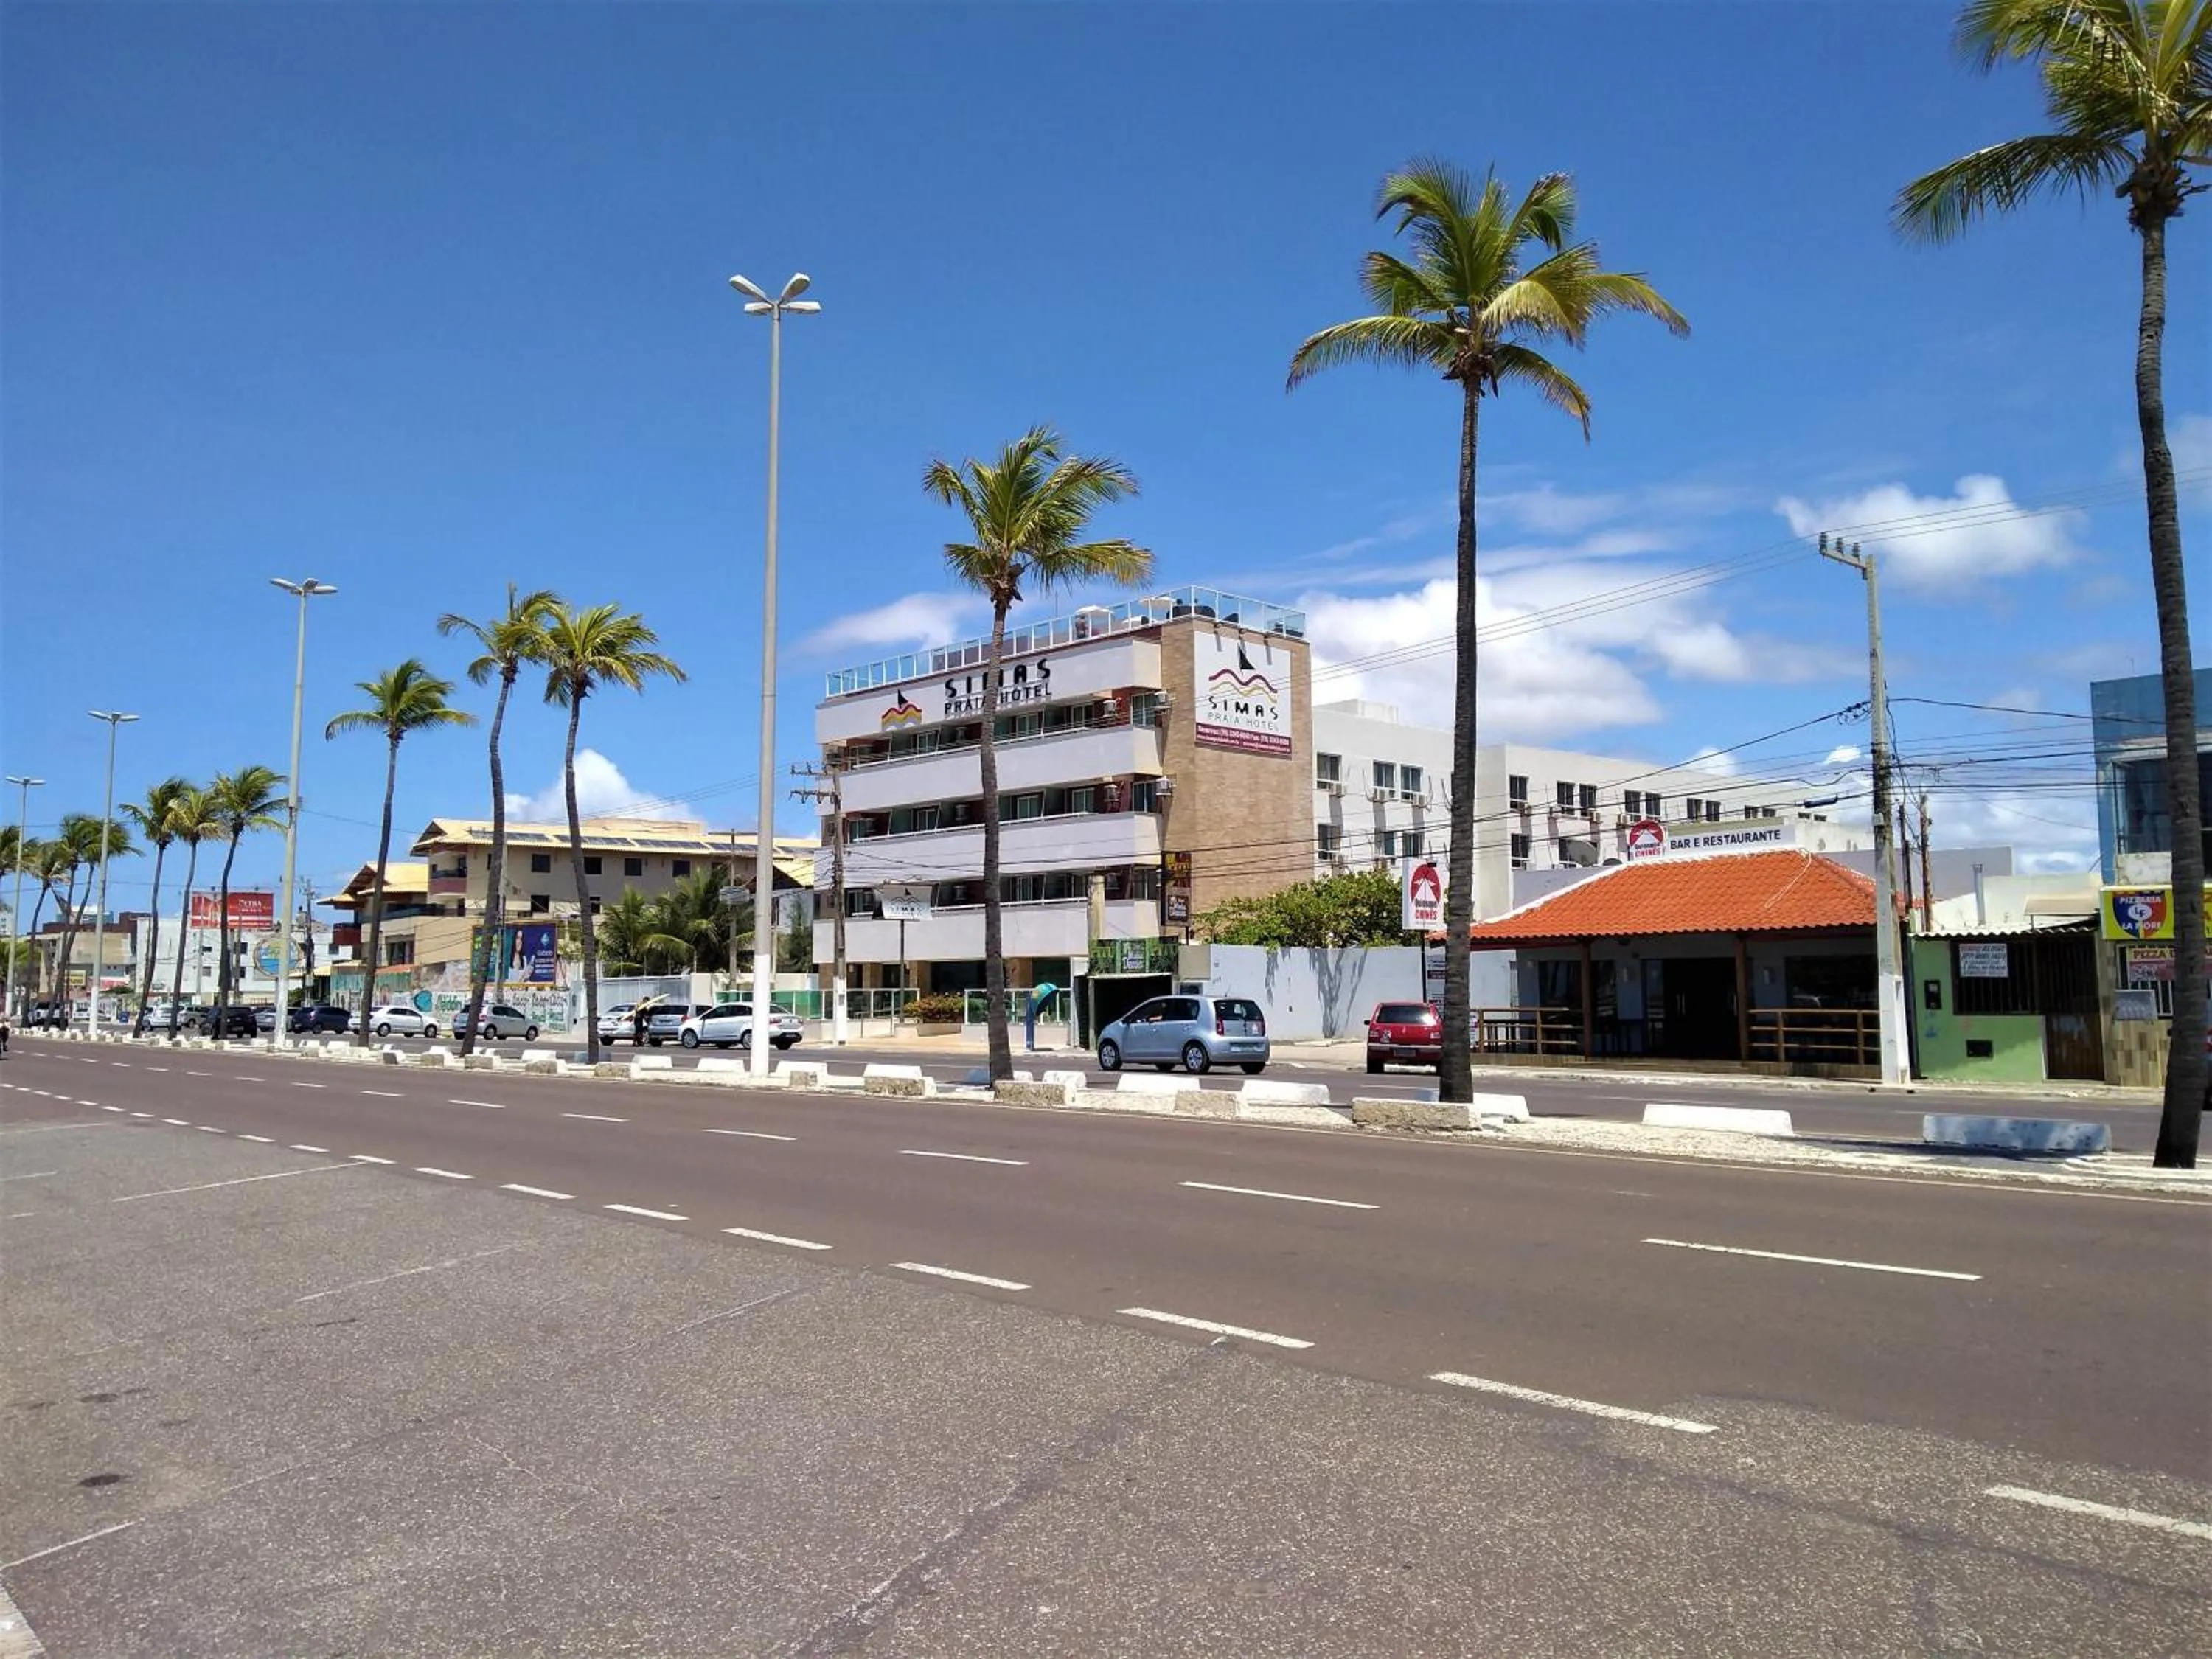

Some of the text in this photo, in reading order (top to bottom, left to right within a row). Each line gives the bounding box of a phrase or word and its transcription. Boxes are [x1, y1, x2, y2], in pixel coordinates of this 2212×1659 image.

[1000, 683, 1052, 704] HOTEL
[1208, 695, 1279, 720] SIMAS
[1208, 712, 1279, 733] PRAIA HOTEL
[1670, 829, 1781, 850] BAR E RESTAURANTE
